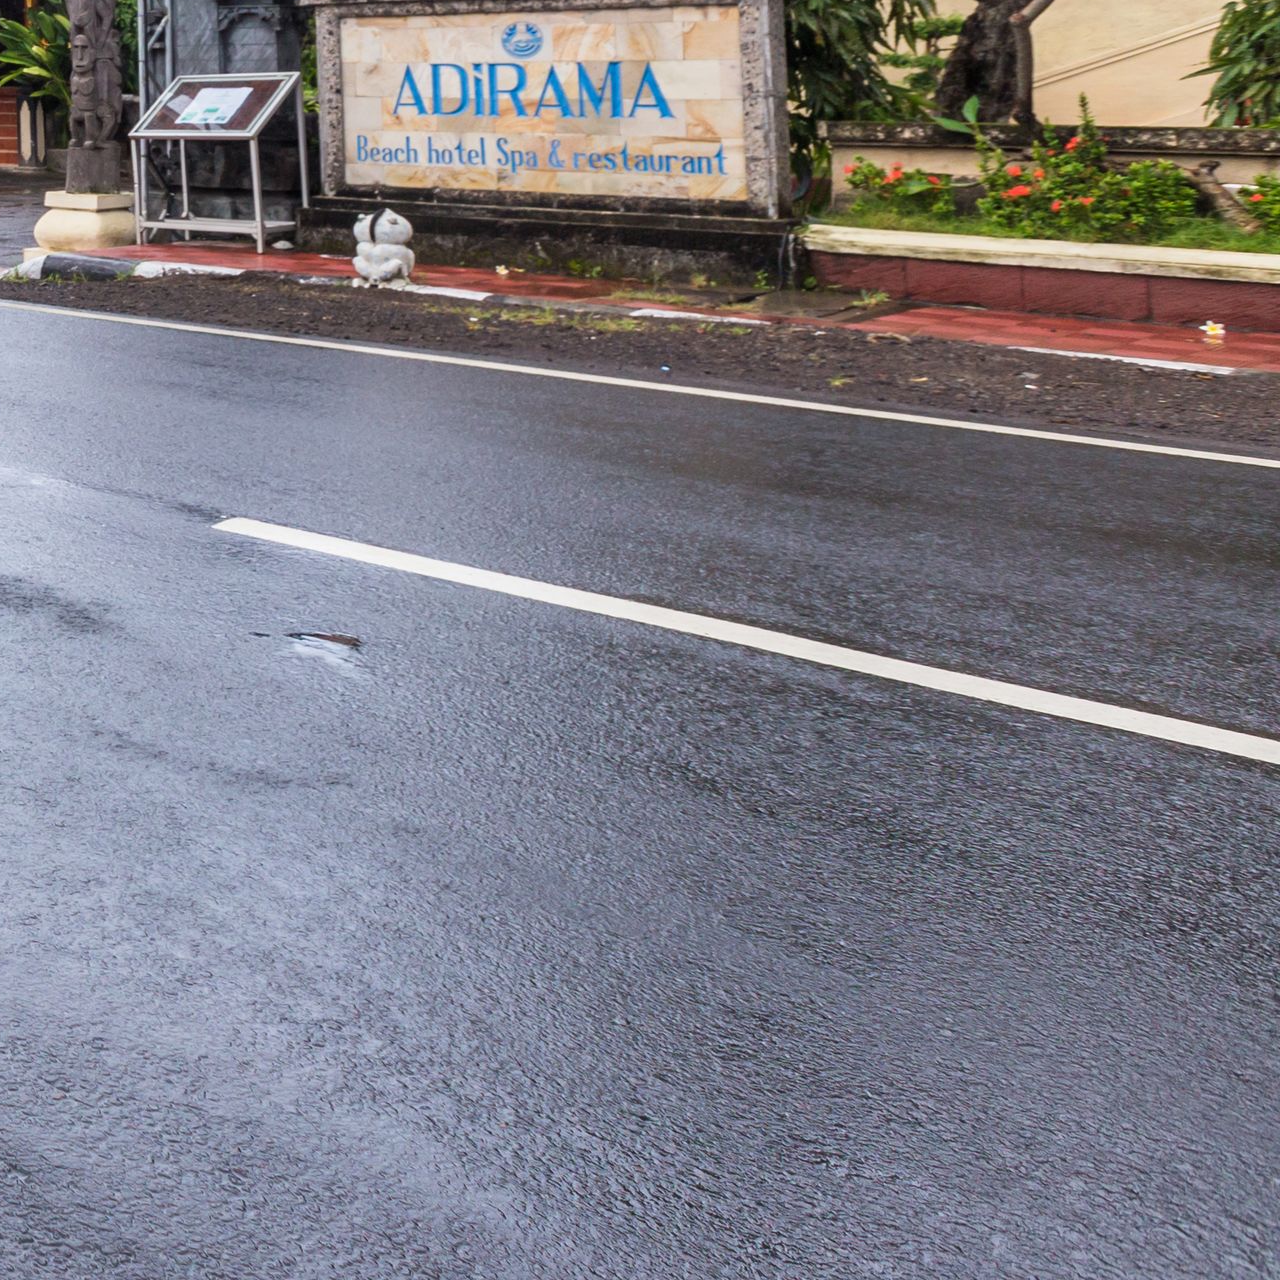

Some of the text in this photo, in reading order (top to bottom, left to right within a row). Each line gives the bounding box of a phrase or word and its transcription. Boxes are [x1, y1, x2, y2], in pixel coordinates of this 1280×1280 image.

[356, 134, 728, 177] Beach hotel Spa & restaurant
